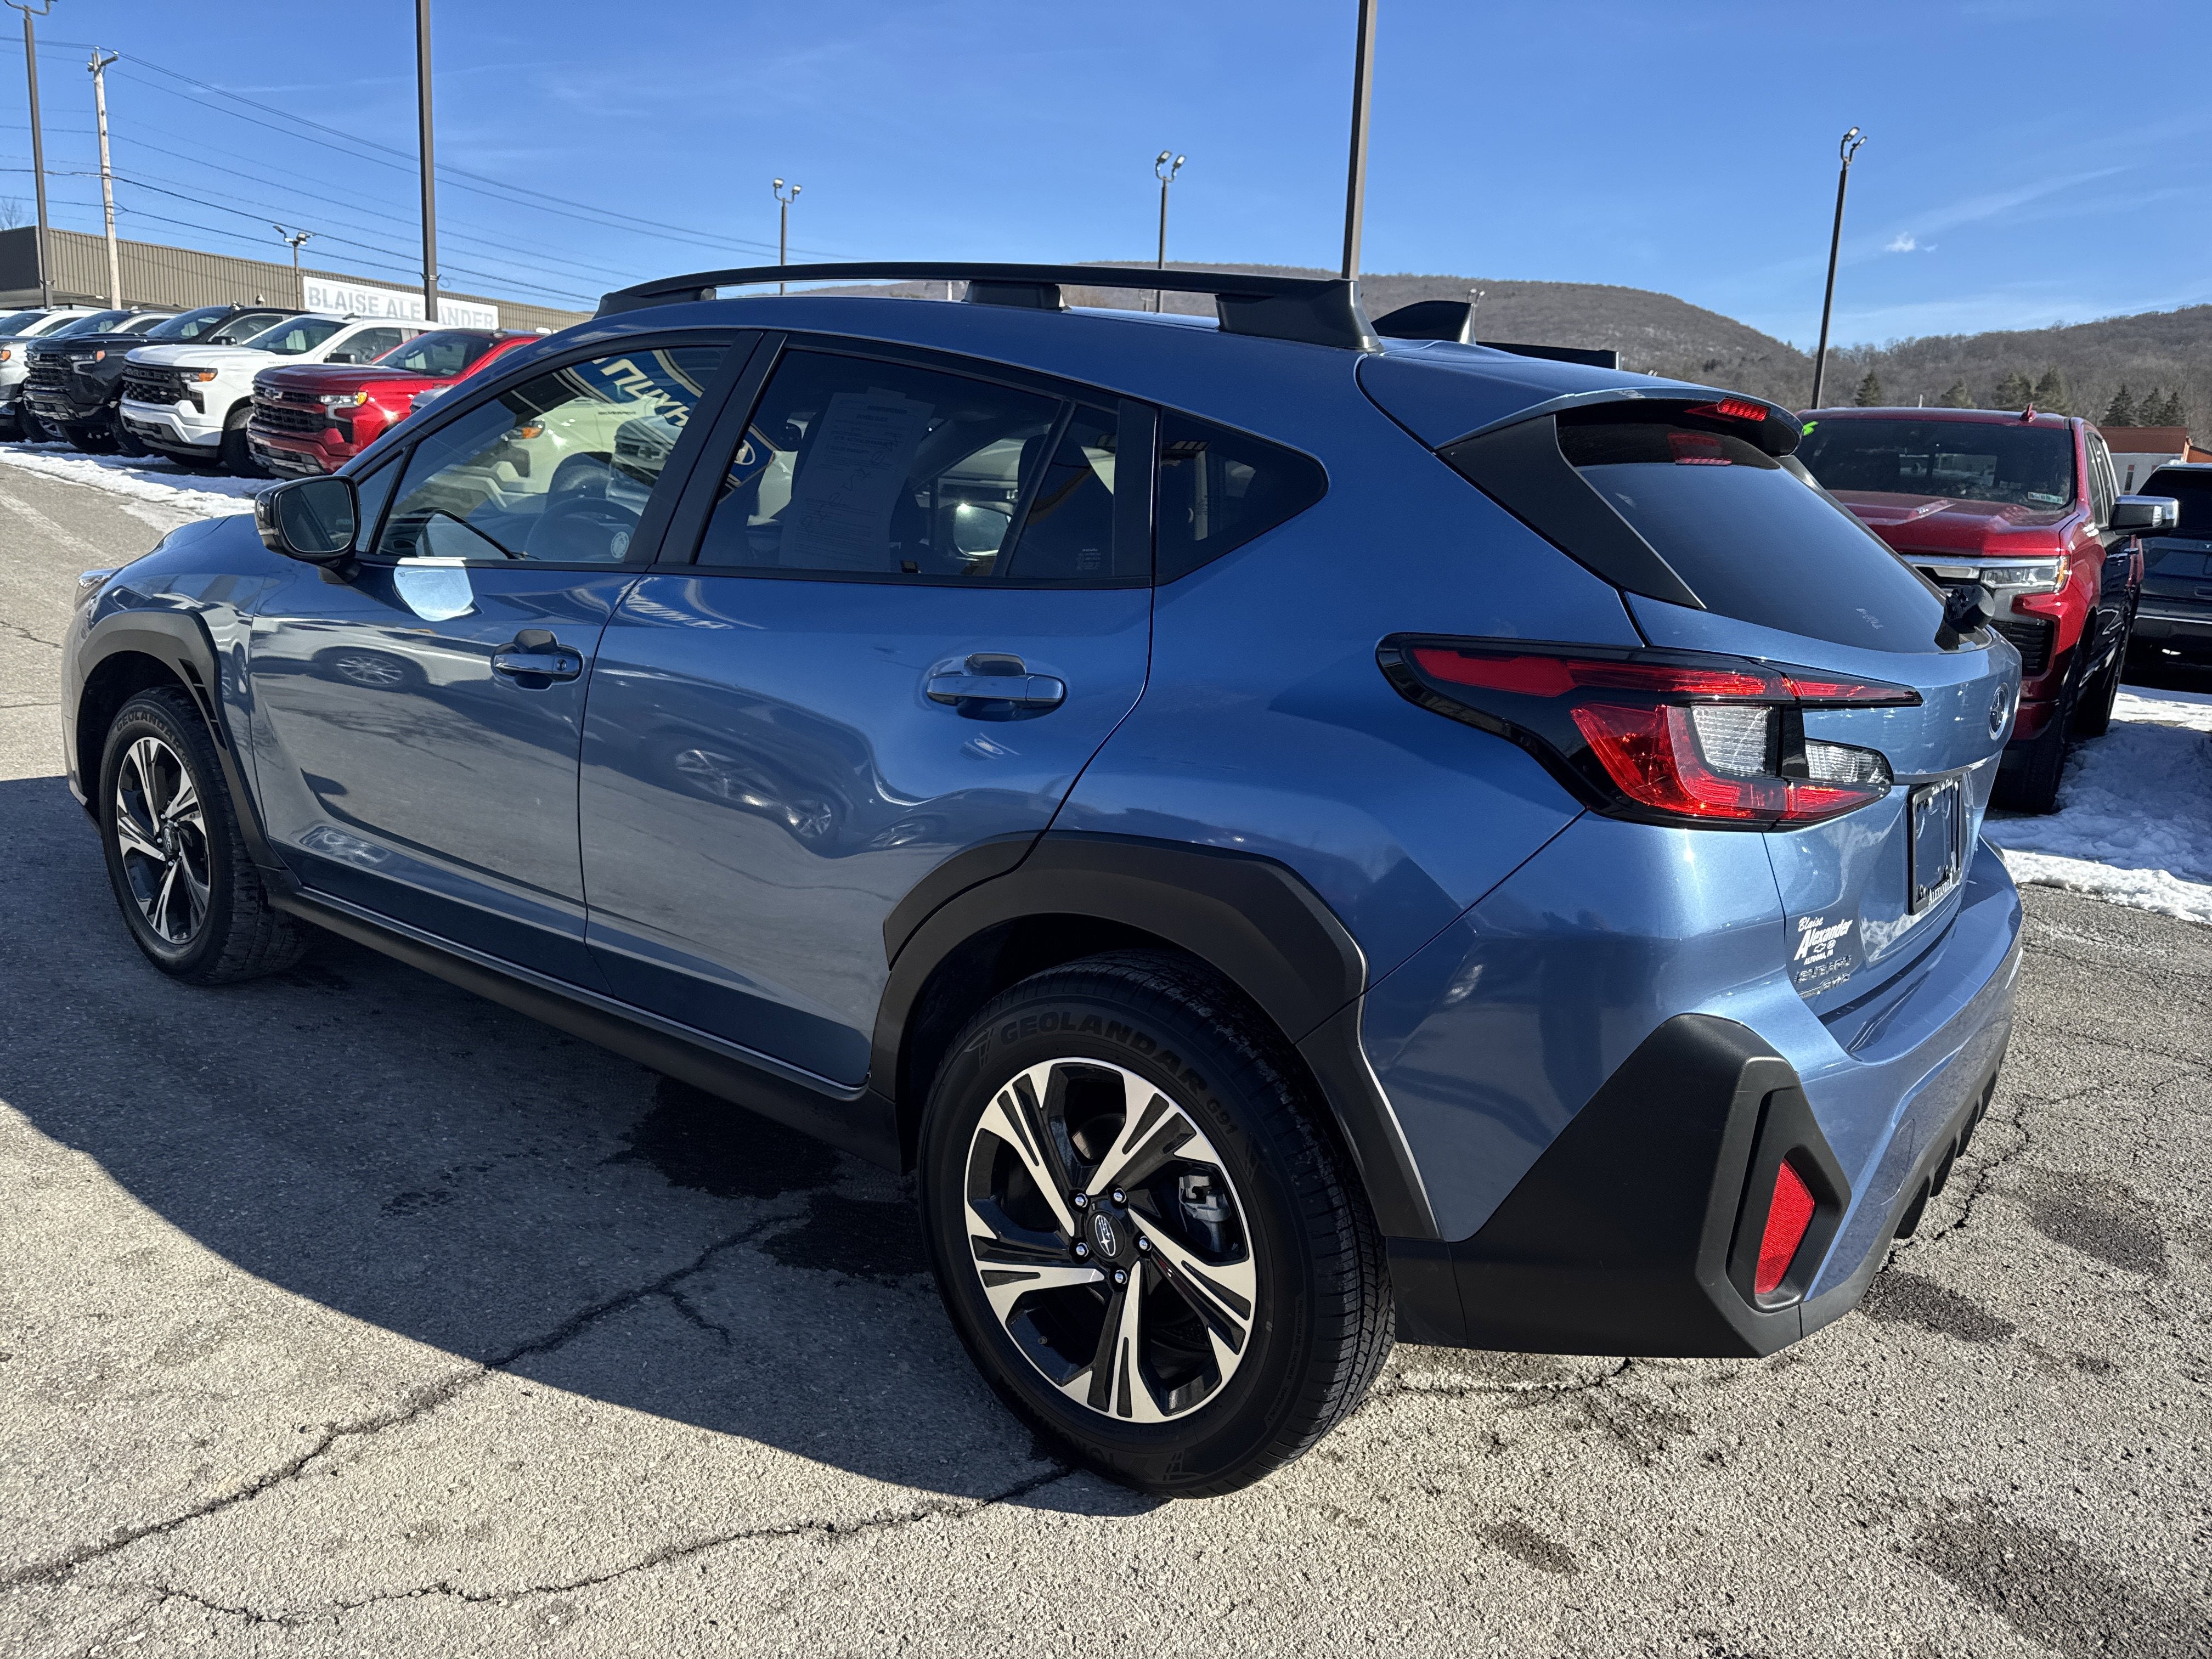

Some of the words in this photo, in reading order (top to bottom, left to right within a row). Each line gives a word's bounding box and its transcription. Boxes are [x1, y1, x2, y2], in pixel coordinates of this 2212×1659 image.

[308, 286, 380, 315] BLAISE
[386, 298, 494, 330] ALEANDER
[1793, 919, 1853, 961] Alexander
[1798, 916, 1824, 932] Blaise
[1000, 1011, 1210, 1096] GEOLANDAR
